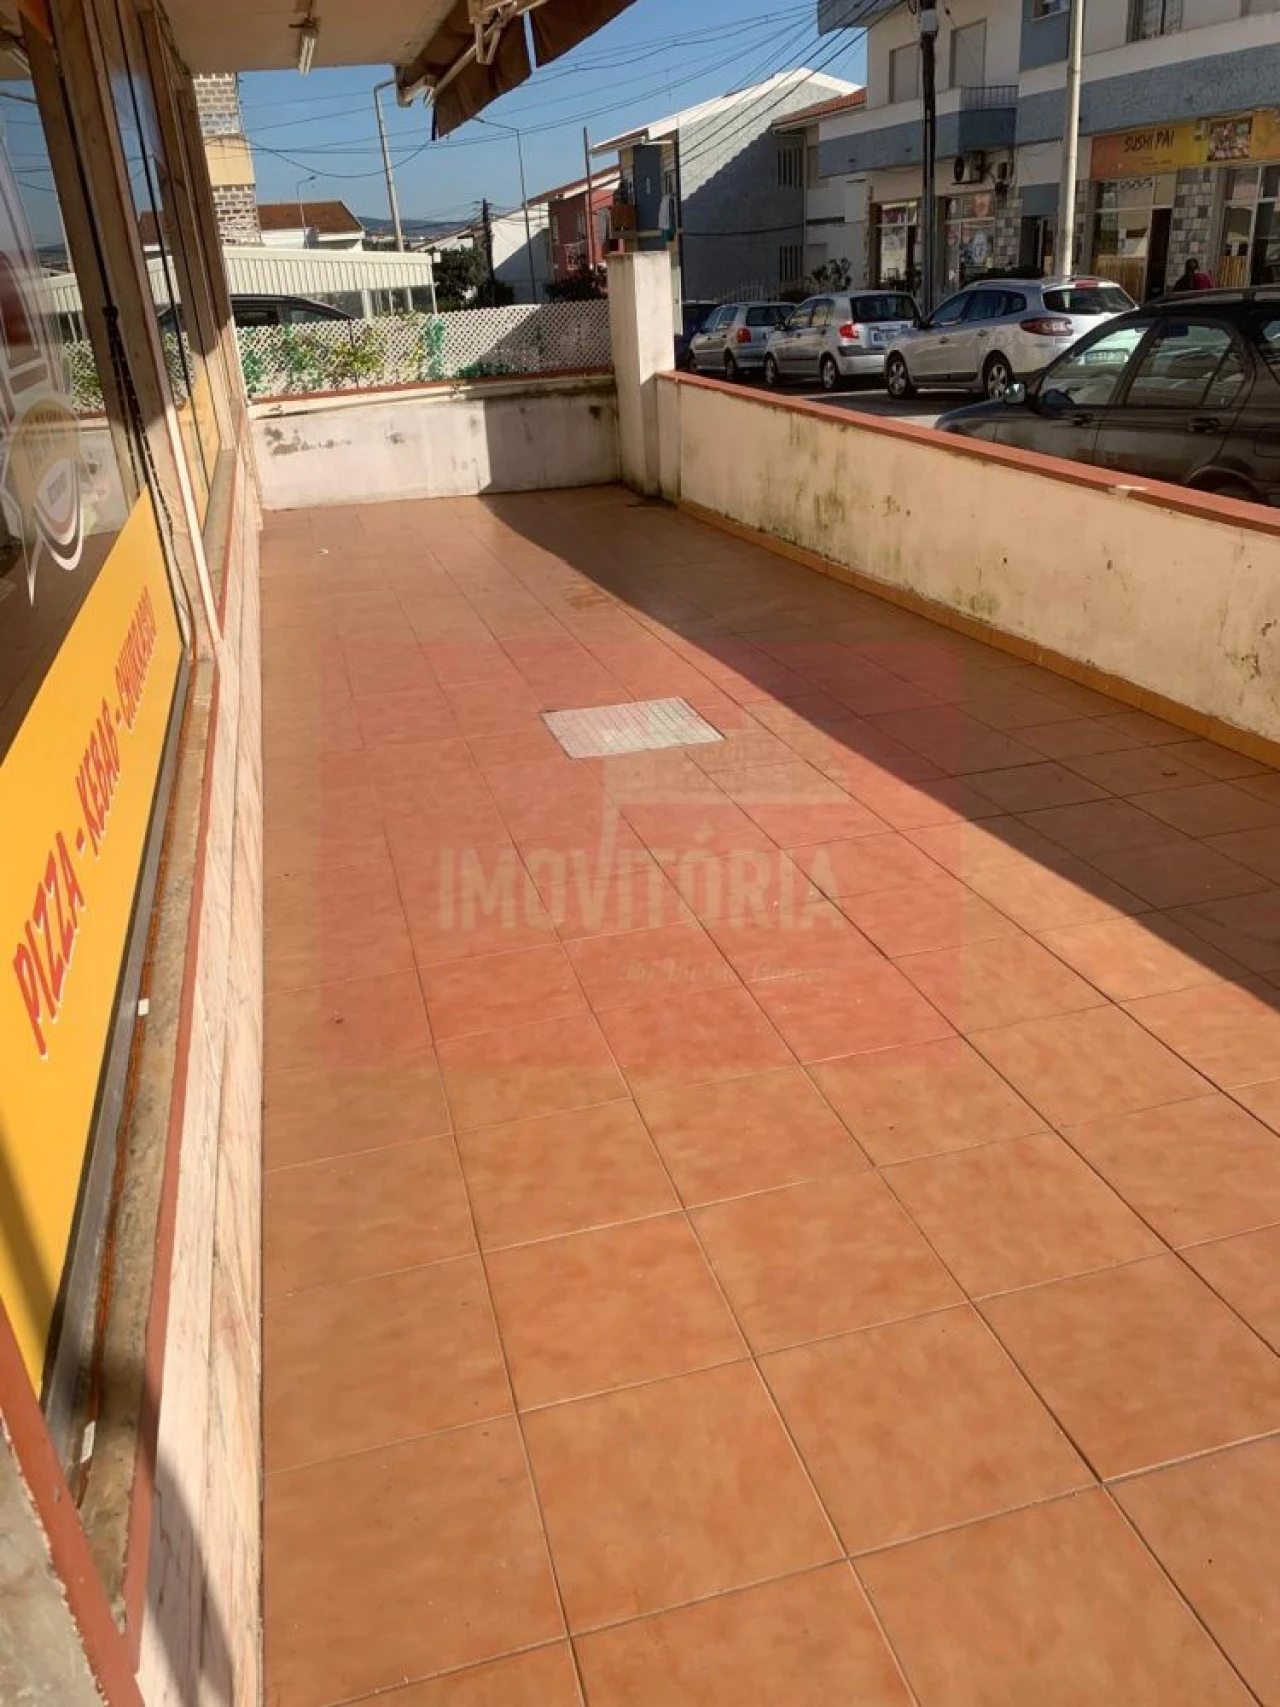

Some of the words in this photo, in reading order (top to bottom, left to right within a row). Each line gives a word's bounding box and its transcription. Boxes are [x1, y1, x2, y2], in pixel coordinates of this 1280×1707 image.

[1124, 132, 1153, 153] SUSHI
[1155, 129, 1175, 150] PAI
[13, 831, 86, 1058] PIZZA
[75, 697, 121, 859] KEBAB
